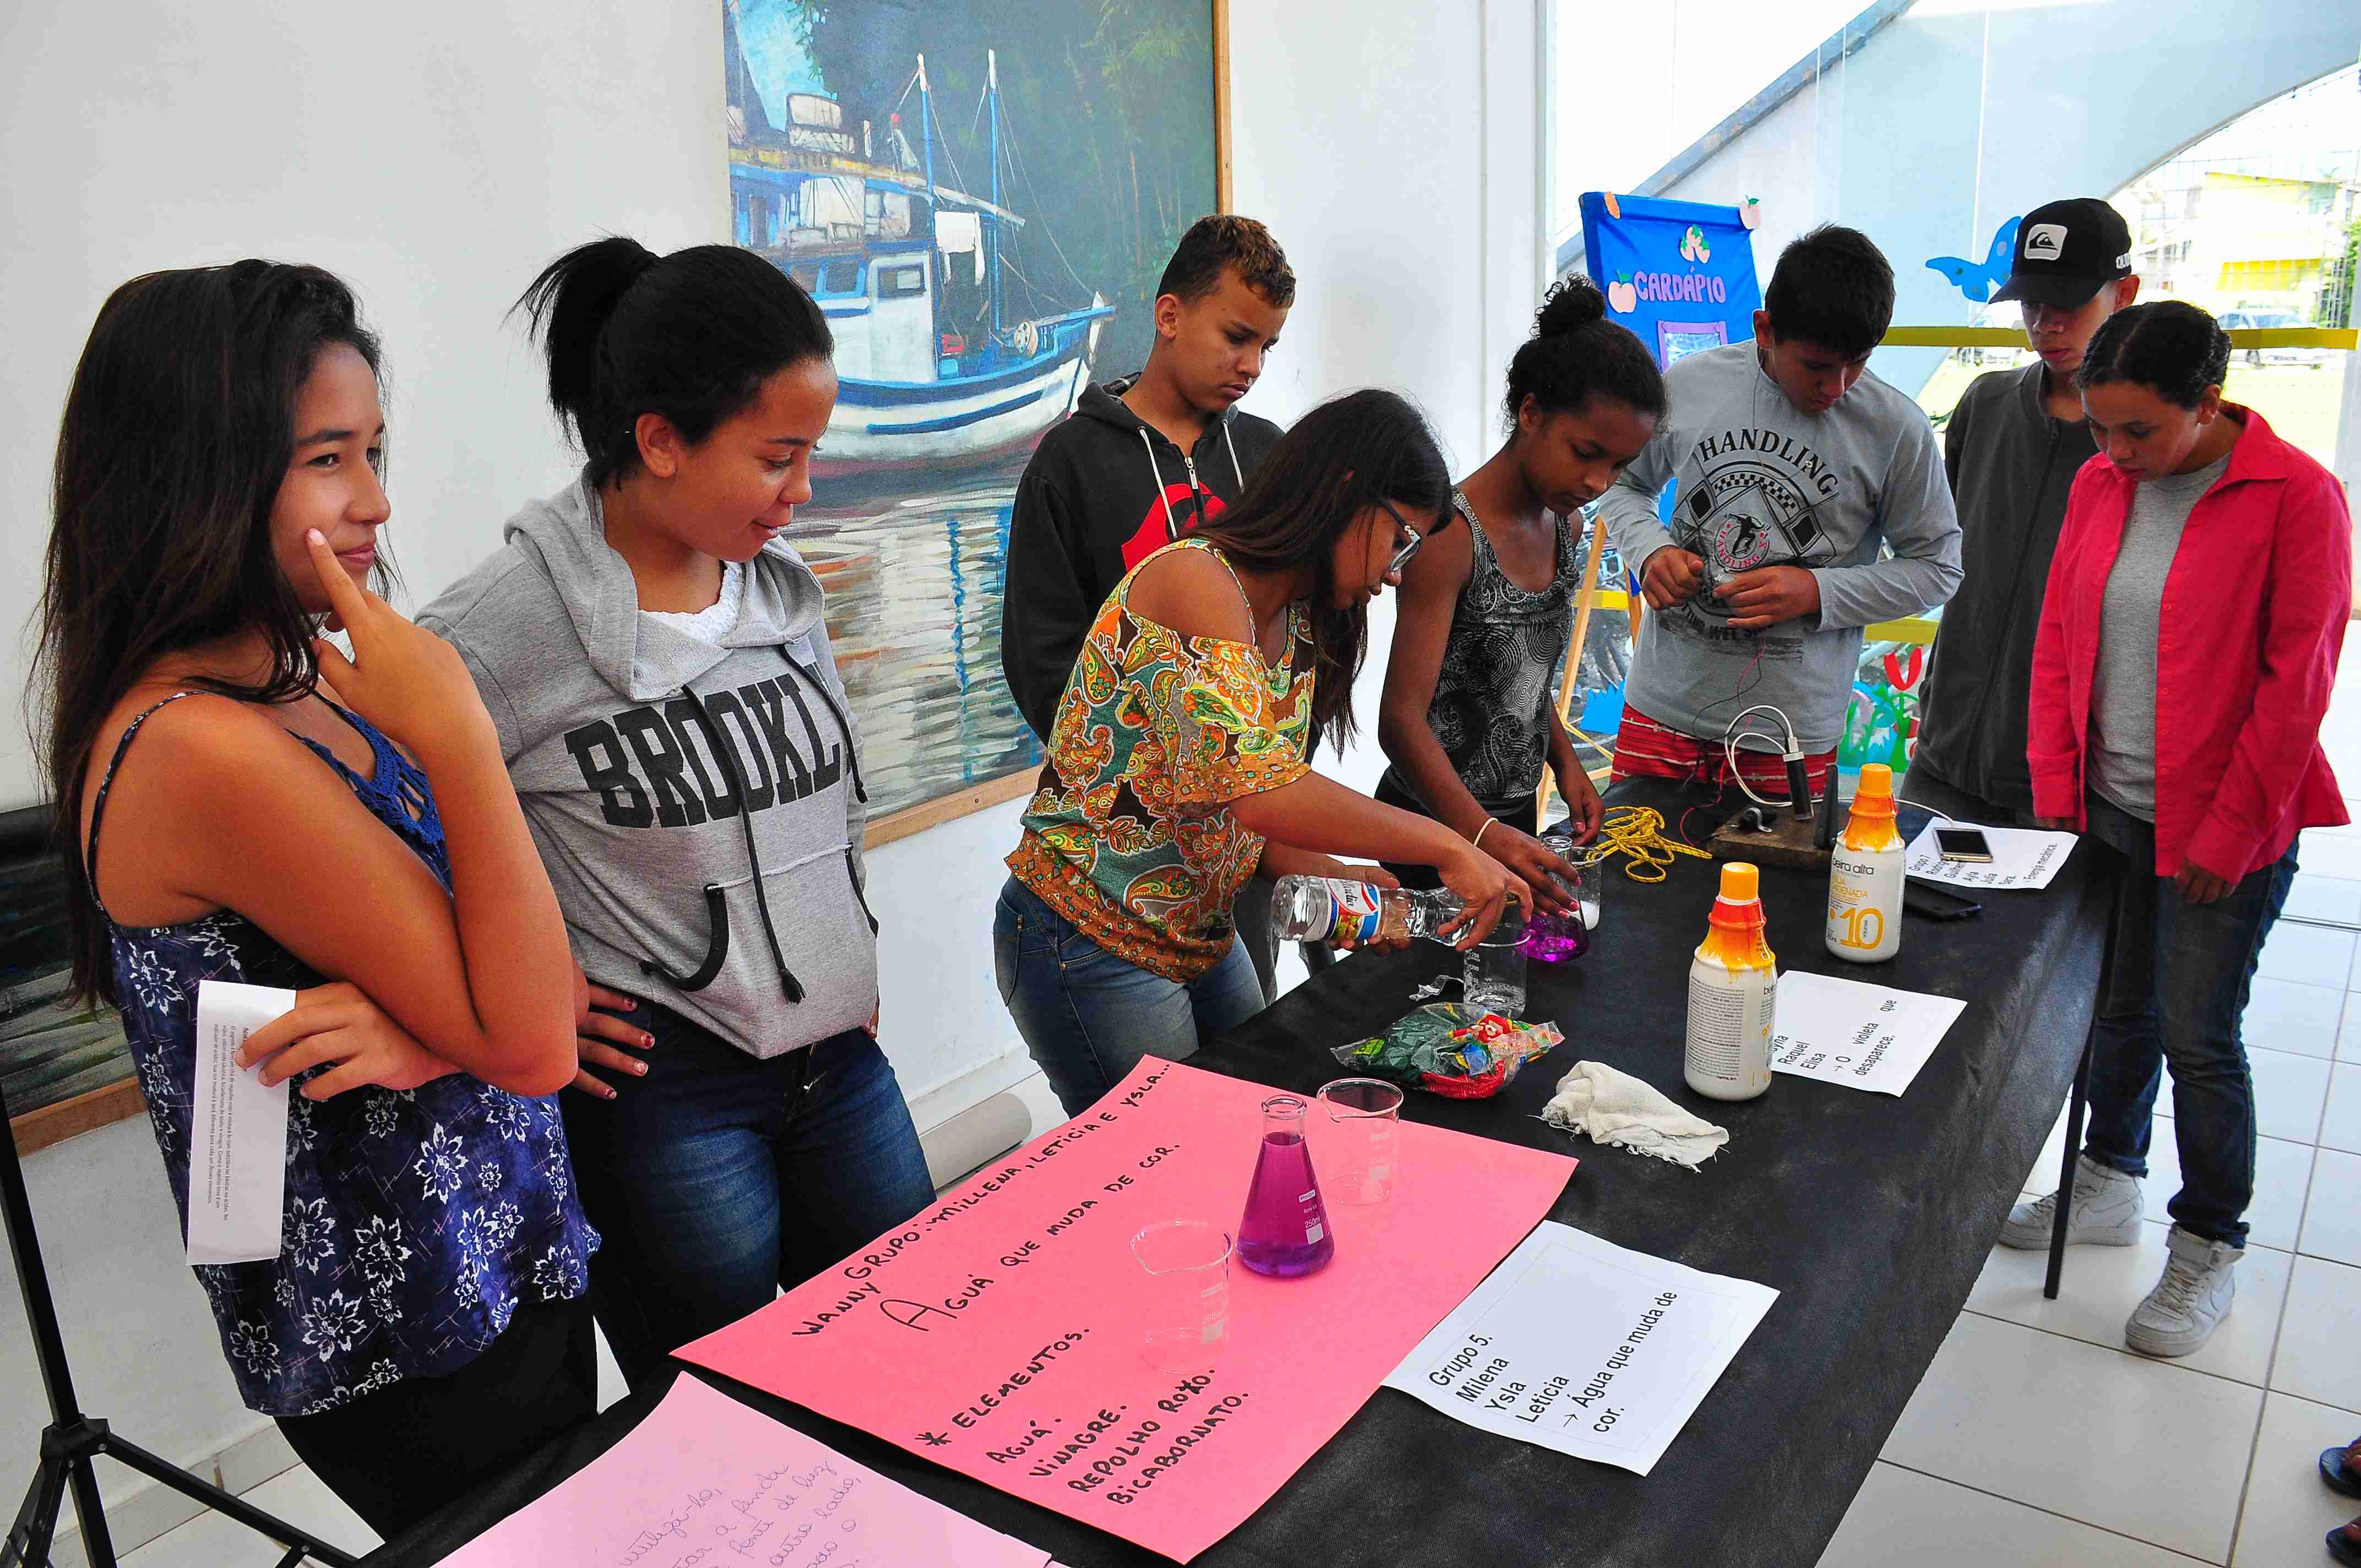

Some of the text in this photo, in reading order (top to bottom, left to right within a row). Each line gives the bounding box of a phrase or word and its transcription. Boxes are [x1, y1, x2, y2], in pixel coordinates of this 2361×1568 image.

[1634, 265, 1726, 303] CARDÁPIO
[1698, 428, 1839, 497] HANDLING
[564, 661, 842, 828] BROOKL
[1853, 864, 1874, 875] alta
[1840, 907, 1885, 950] 10
[1853, 1022, 1879, 1046] violeta
[1880, 1000, 1897, 1012] que
[1777, 1041, 1811, 1065] Raquel
[1800, 1053, 1827, 1070] Elisa
[1853, 1035, 1895, 1076] desaparece.
[1100, 1112, 1118, 1123] E
[1000, 1240, 1041, 1267] QUE
[1046, 1200, 1099, 1236] MUDA
[1104, 1174, 1135, 1193] DE
[1139, 1144, 1181, 1169] COR.
[791, 1282, 882, 1336] WANNY
[1429, 1333, 1493, 1386] Grupo 5.
[1566, 1292, 1678, 1408] Água que muda de
[951, 1329, 1090, 1429] ELEMENTOS.
[1455, 1358, 1510, 1403] Milena
[1484, 1381, 1527, 1411] Ysla
[1593, 1407, 1625, 1433] cor.
[1067, 1420, 1161, 1493] REPOLHO
